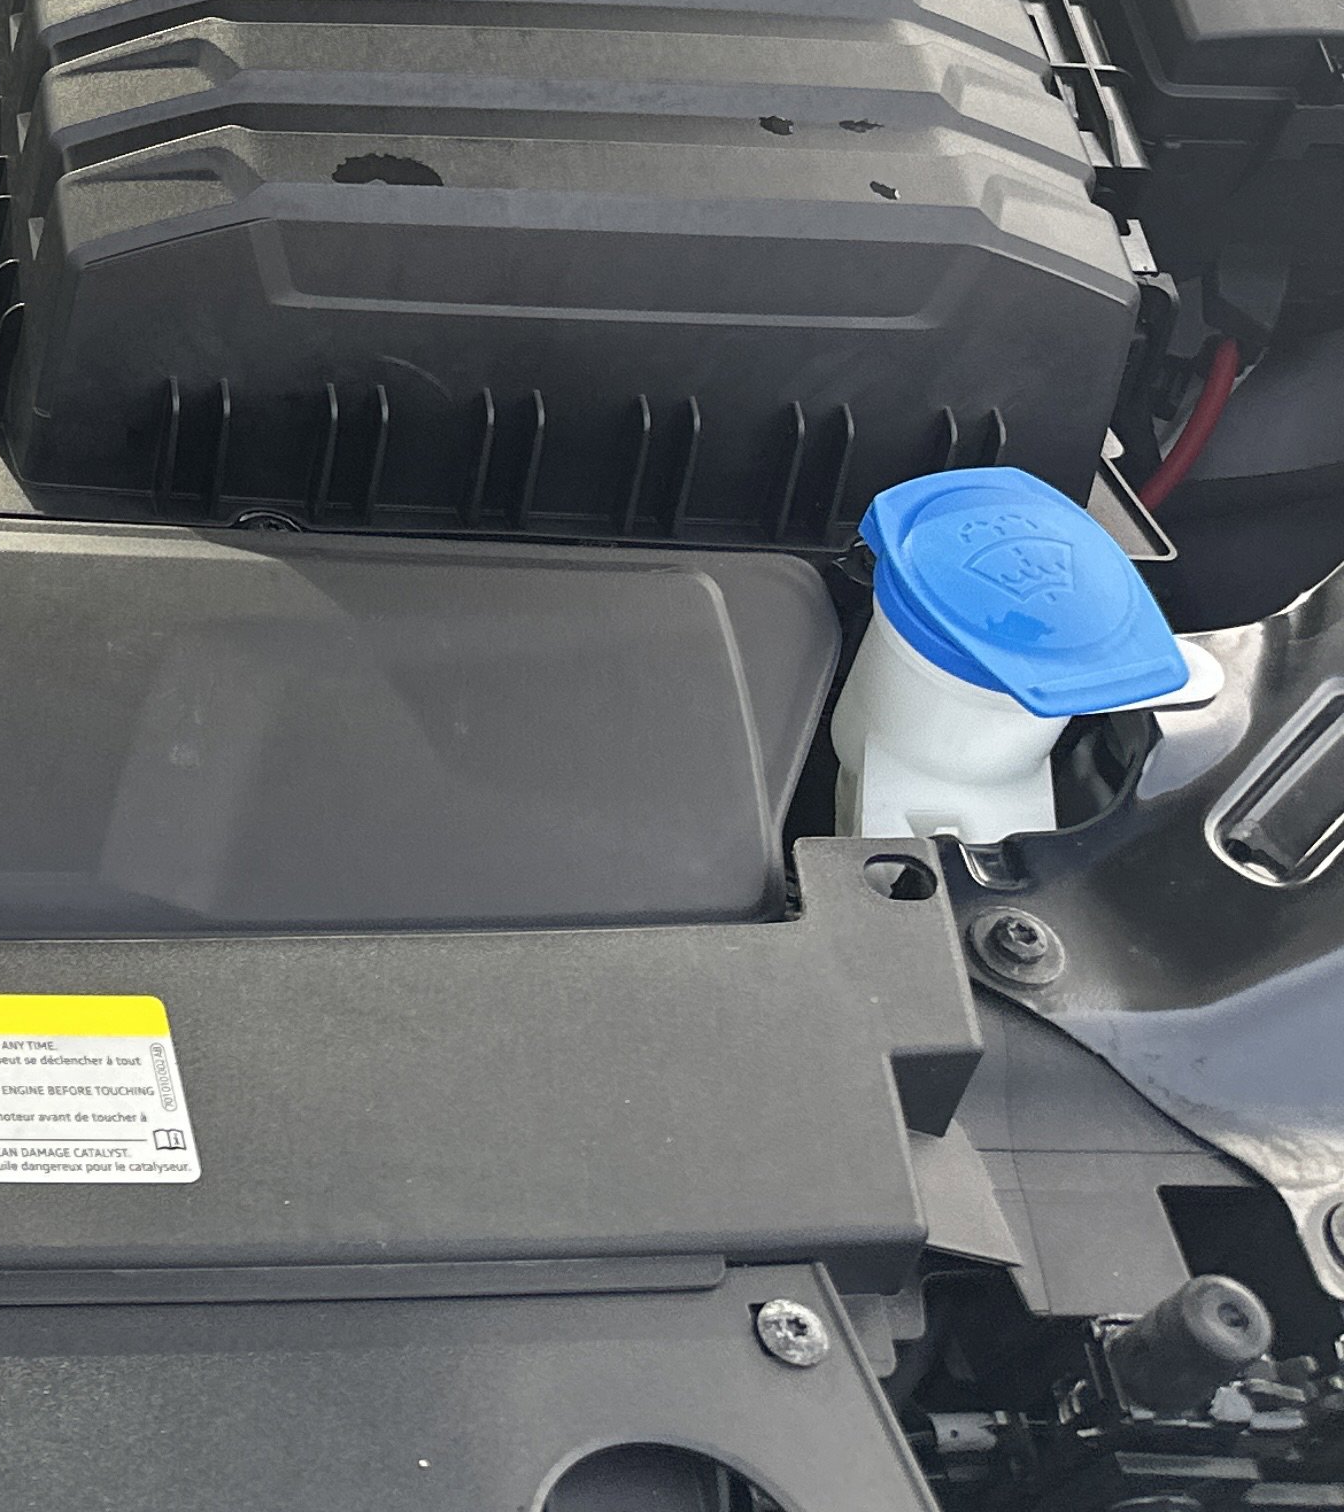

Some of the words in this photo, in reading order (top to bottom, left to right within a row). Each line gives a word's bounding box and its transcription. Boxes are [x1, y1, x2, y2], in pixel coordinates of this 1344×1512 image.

[2, 1041, 25, 1051] ANY
[28, 1041, 58, 1051] TIME.
[40, 1055, 102, 1066] déclencher
[116, 1057, 141, 1066] tout
[2, 1086, 45, 1095] ENGINE
[48, 1086, 92, 1096] BEFORE
[96, 1086, 155, 1096] TOUCHING
[38, 1114, 71, 1122] avant
[92, 1113, 136, 1122] toucher
[21, 1148, 71, 1157] DAMAGE
[74, 1148, 132, 1158] CATALYST.
[21, 1161, 82, 1173] dangereux
[86, 1163, 112, 1172] pour
[129, 1163, 192, 1173] catalyseur.
